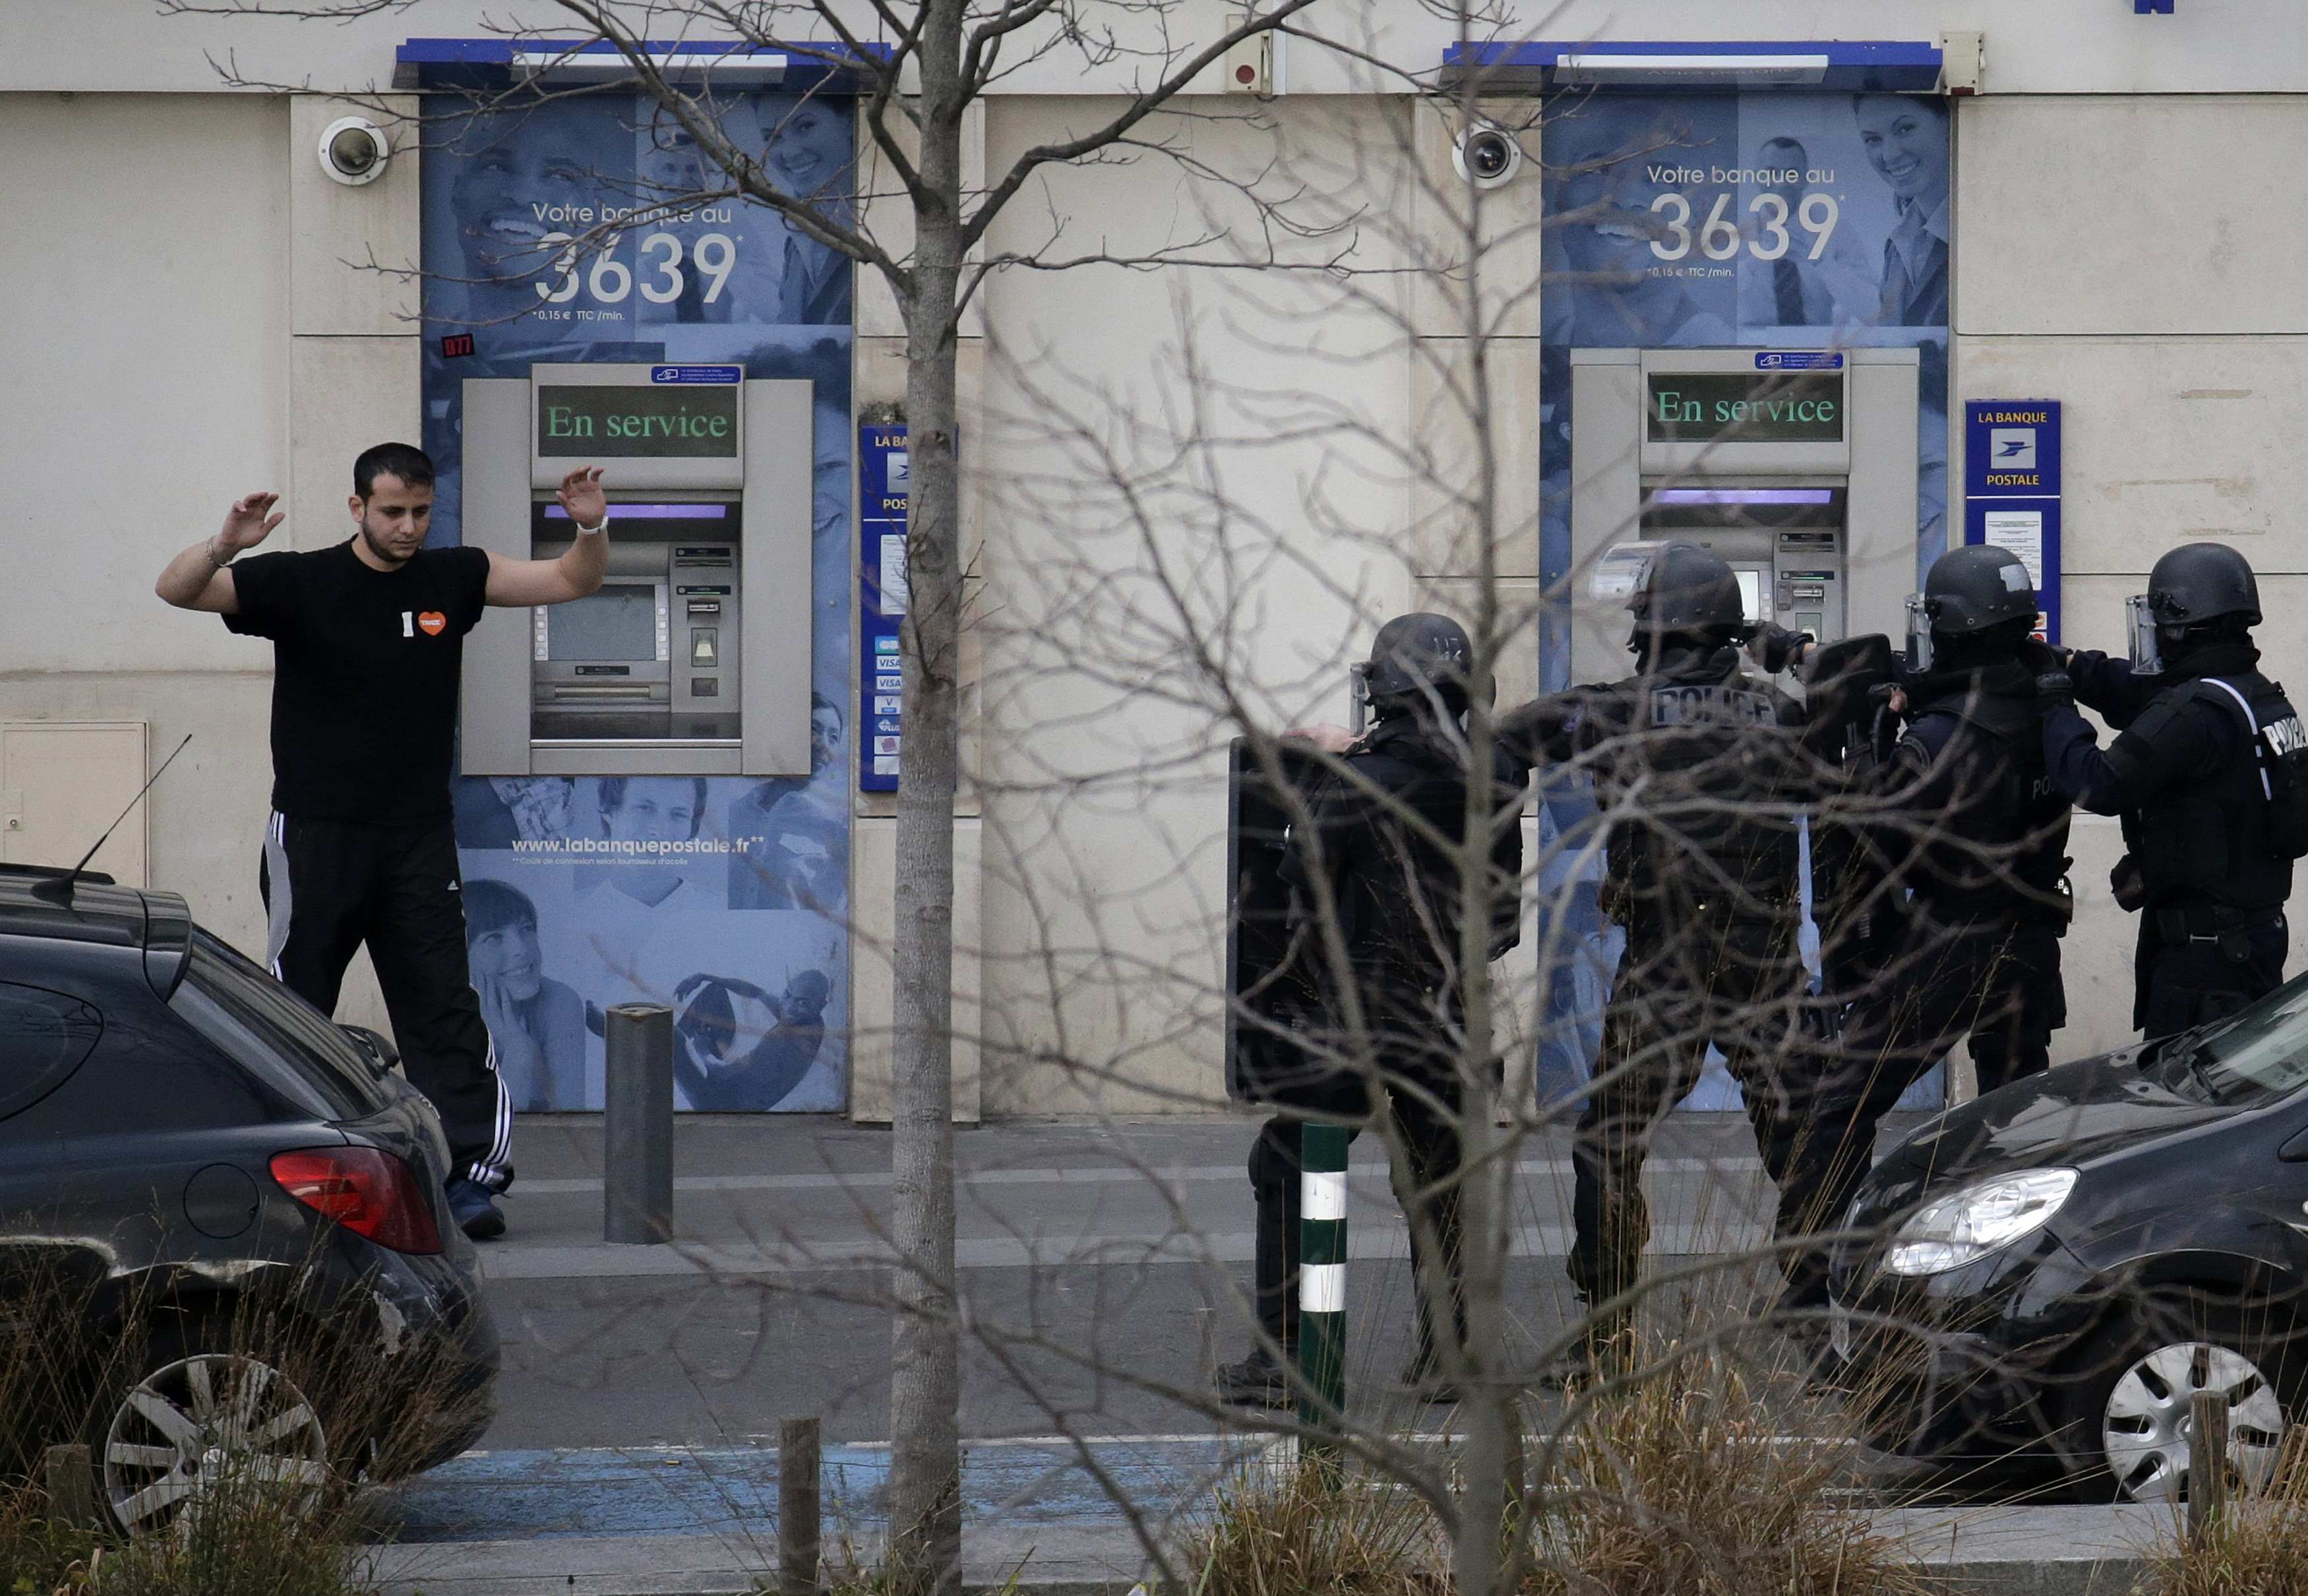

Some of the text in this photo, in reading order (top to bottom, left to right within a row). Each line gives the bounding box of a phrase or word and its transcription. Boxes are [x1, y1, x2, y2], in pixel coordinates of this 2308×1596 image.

[1647, 165, 1835, 187] Votre banque au
[533, 202, 732, 226] Votre banque au
[1688, 267, 1705, 276] TTC
[1707, 267, 1734, 278] /min.
[562, 311, 570, 321] €
[576, 310, 593, 320] TTC
[597, 310, 625, 321] /min.
[1656, 390, 1835, 422] En service
[547, 406, 727, 437] En service
[1978, 412, 2048, 424] LA BANQUE
[875, 436, 908, 446] LA BA
[1987, 474, 2040, 485] POSTALE
[402, 611, 413, 637] I
[879, 659, 901, 667] VISA
[879, 679, 901, 687] VISA
[2032, 775, 2053, 801] PO
